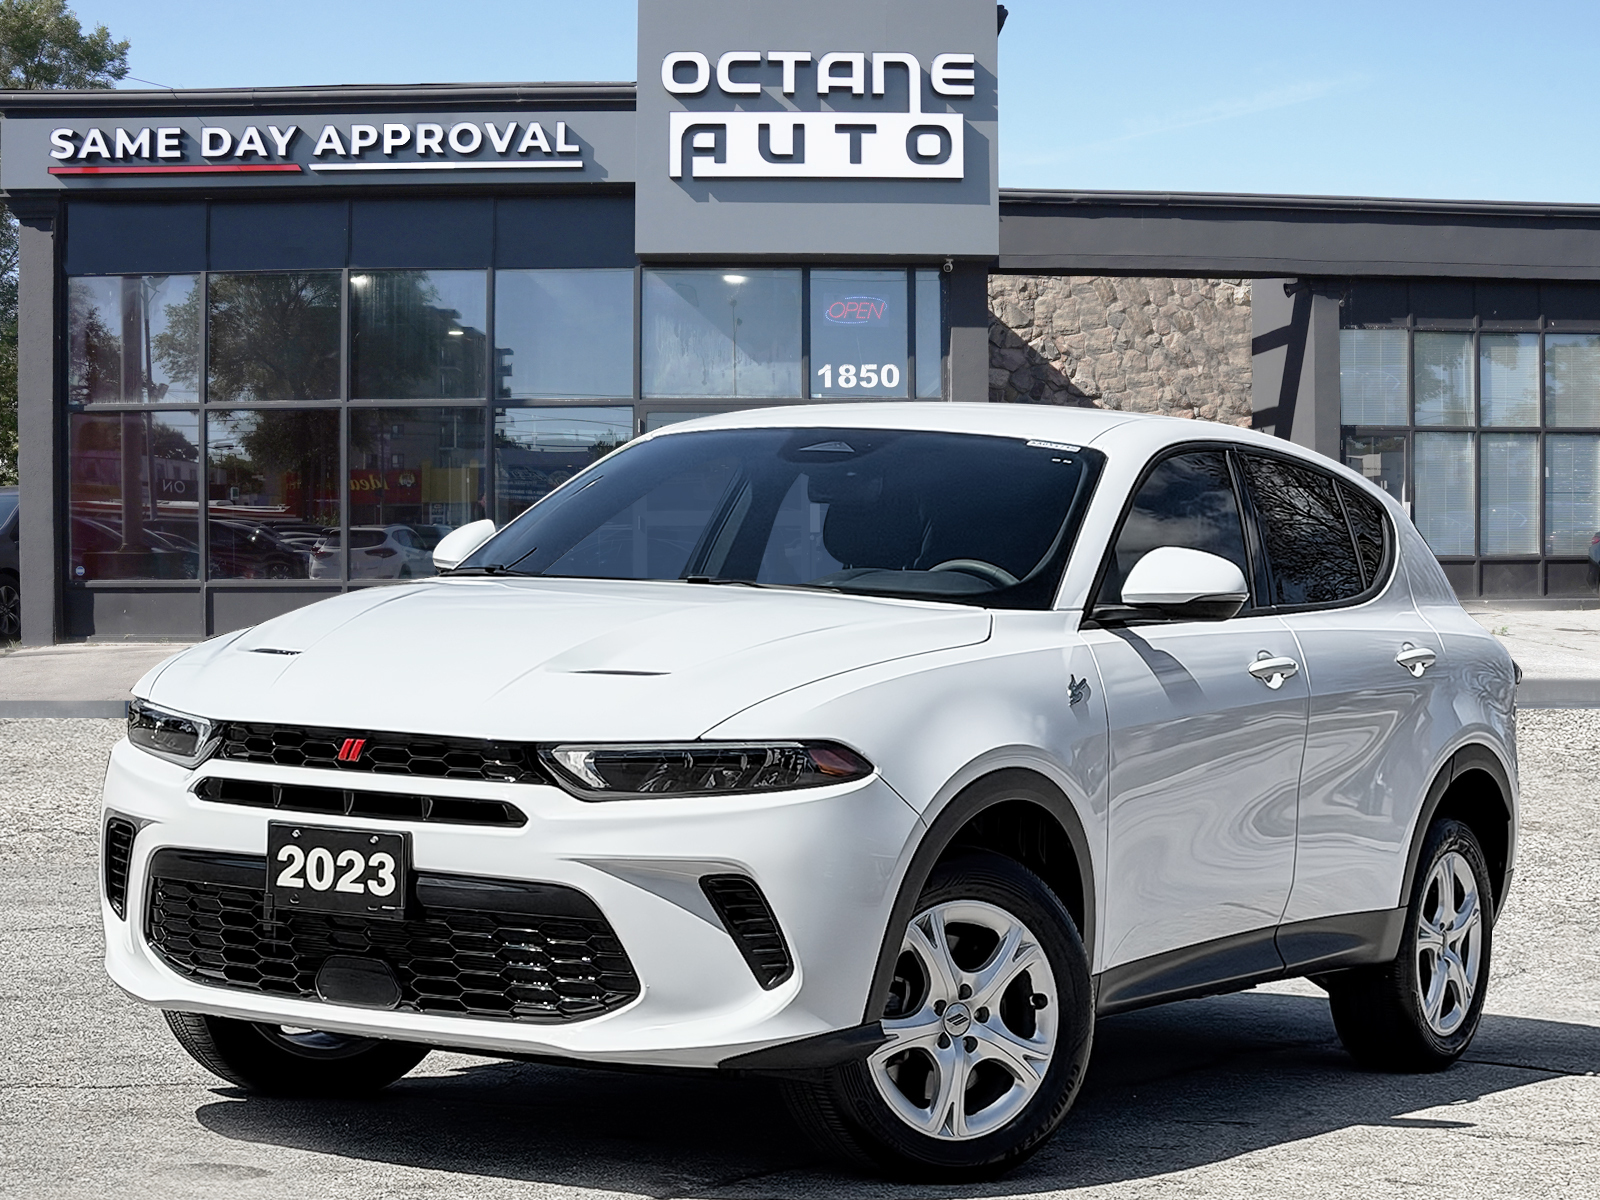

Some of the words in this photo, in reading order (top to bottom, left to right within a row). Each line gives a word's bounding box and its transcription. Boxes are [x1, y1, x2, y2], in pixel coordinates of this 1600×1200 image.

[661, 51, 975, 113] OCTANE
[49, 127, 181, 160] SAME
[201, 125, 298, 157] DAY
[312, 121, 580, 154] APPROVAL
[681, 123, 952, 177] AUTO
[829, 302, 885, 319] OPEN
[818, 364, 900, 388] 1850
[276, 845, 396, 897] 2023
